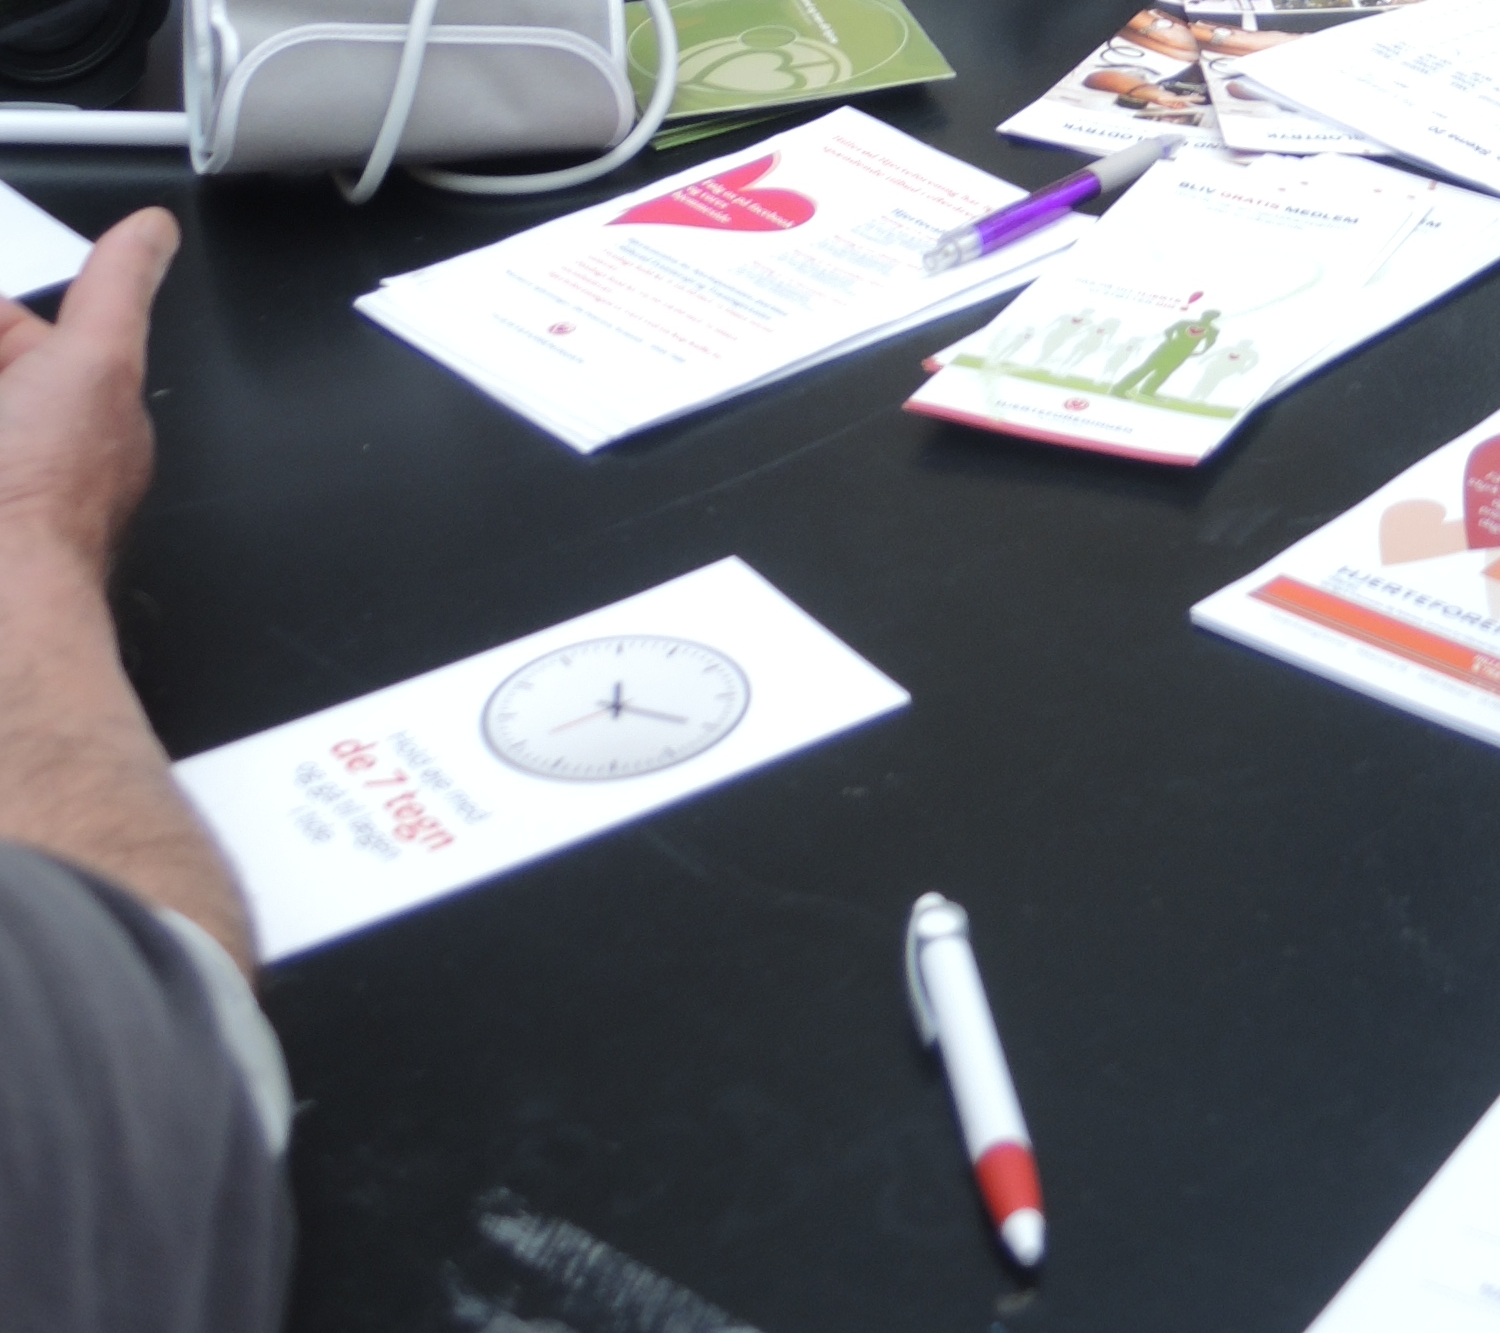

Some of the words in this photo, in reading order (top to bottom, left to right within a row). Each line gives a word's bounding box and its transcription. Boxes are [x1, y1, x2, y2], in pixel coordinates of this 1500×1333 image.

[1179, 181, 1217, 194] BLIV
[1220, 190, 1280, 210] GRATIS
[1285, 205, 1359, 225] MEDLEM
[330, 738, 379, 774] de
[362, 767, 410, 789] 7
[384, 790, 456, 853] tegn
